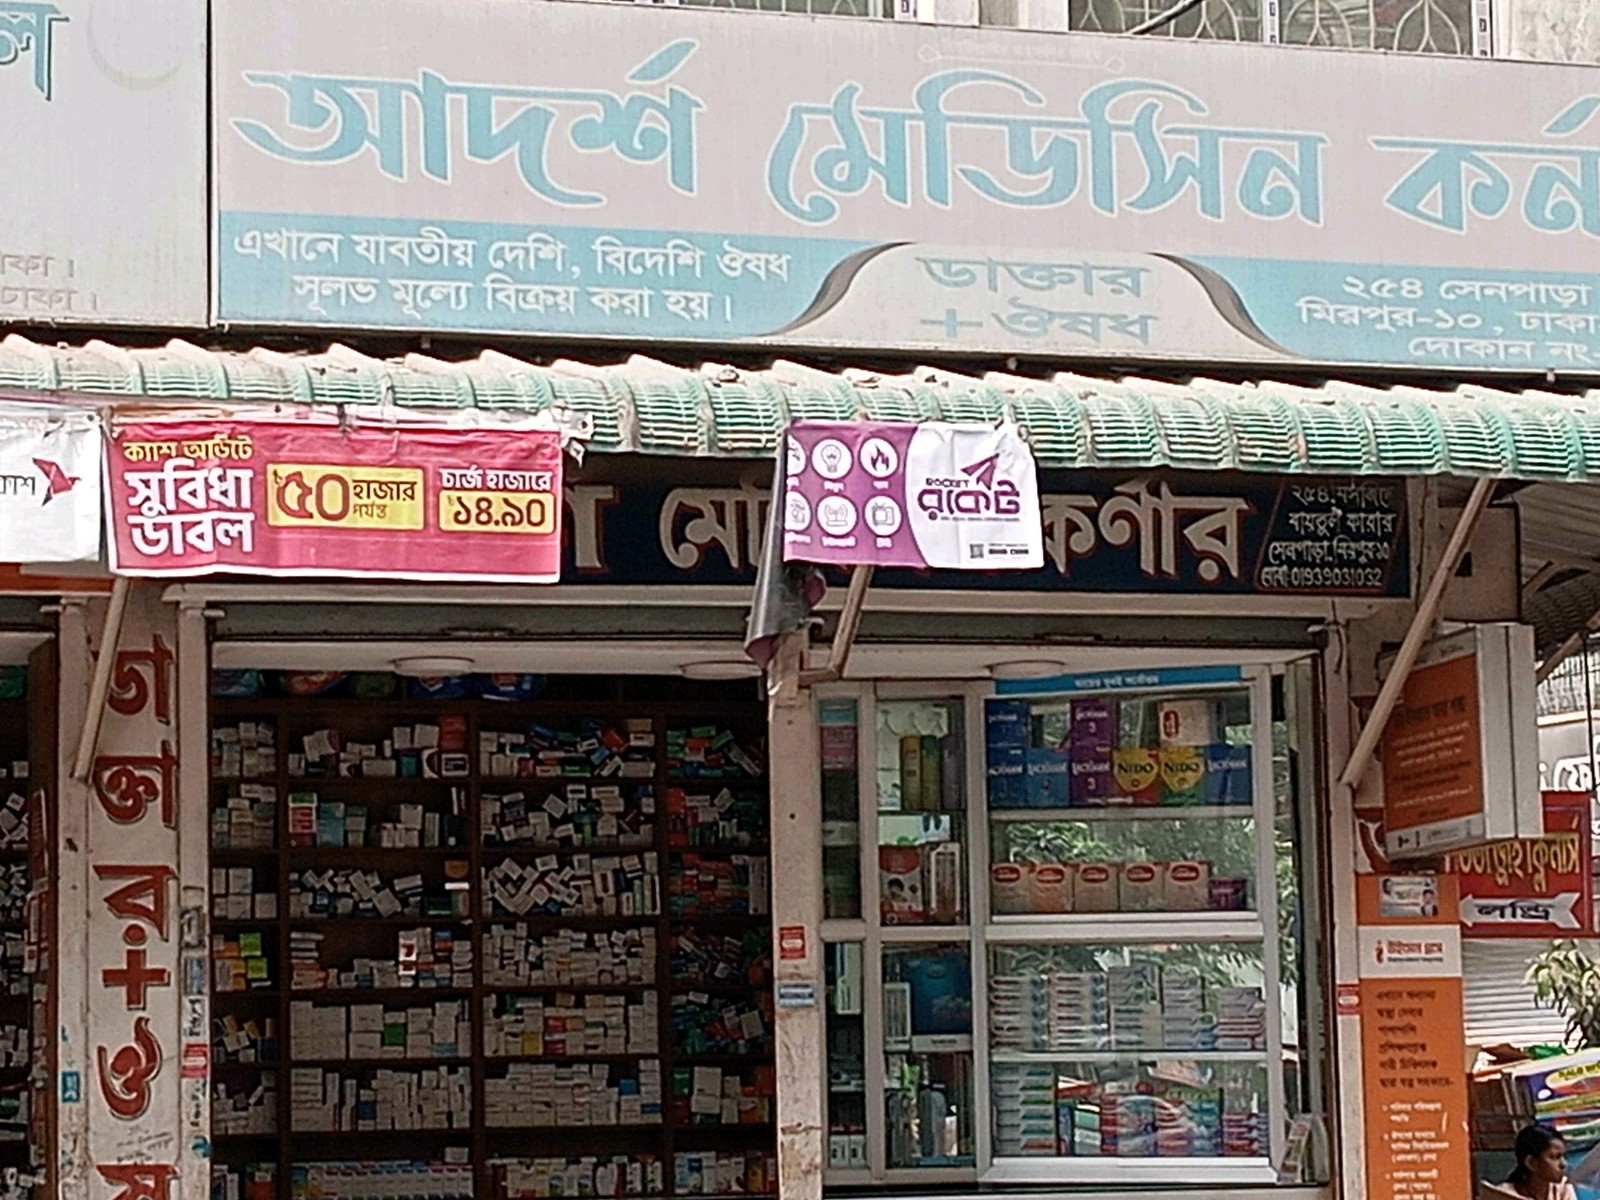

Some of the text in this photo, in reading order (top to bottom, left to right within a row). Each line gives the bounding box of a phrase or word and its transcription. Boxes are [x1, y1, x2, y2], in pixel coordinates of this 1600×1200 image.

[233, 39, 706, 205] আদর্শ
[768, 67, 1331, 225] মেডিসিন
[234, 229, 343, 262] এখানে
[351, 226, 477, 269] যাবতীয়
[591, 235, 706, 279] বিদেশি
[716, 239, 791, 283] ঔষধ
[388, 278, 473, 319] মূল্যে
[482, 273, 579, 315] বিক্রয়
[586, 284, 654, 318] করা
[915, 256, 1153, 298] ডাক্তার
[1342, 275, 1592, 306] ২৫৪ সেনপাড়া
[991, 297, 1159, 346] ঔষধ
[1408, 334, 1535, 361] দোকান
[122, 433, 254, 462] ক্যাশ আউটে
[123, 457, 254, 517] সুবিধা
[352, 479, 418, 502] হাজার
[440, 464, 553, 491] চার্জ হাজারে
[127, 510, 256, 556] ডাবল
